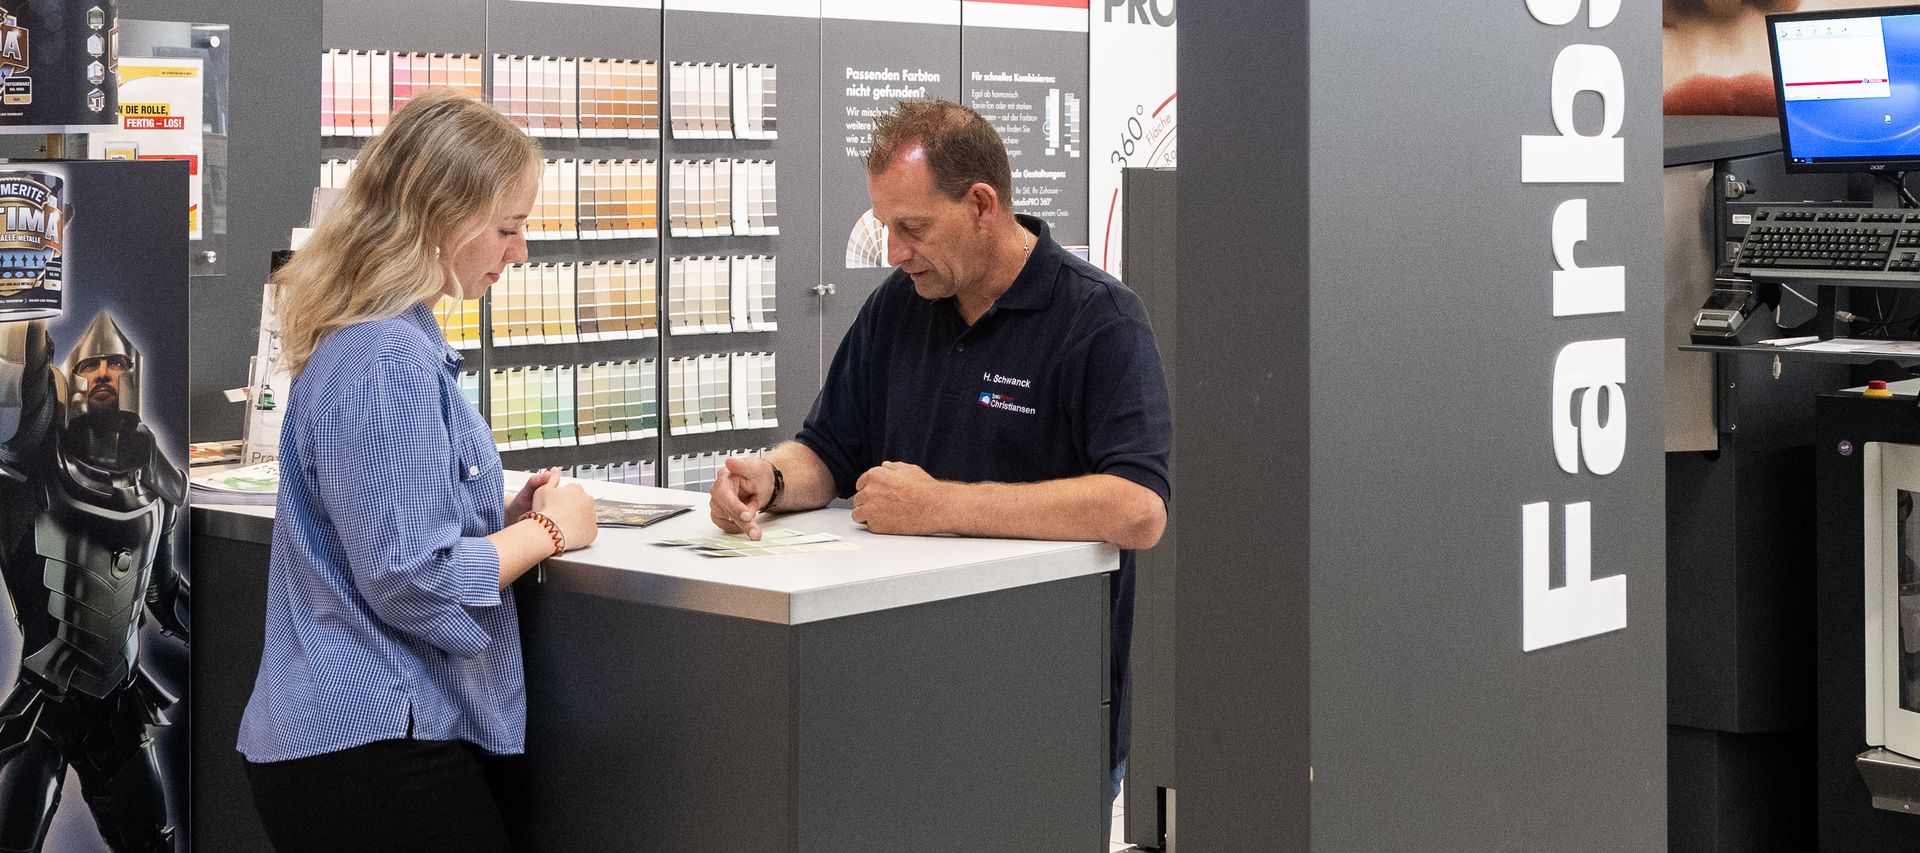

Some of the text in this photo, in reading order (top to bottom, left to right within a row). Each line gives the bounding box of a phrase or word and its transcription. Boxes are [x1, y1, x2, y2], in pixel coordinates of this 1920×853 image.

[846, 67, 940, 82] Passenden Farbton
[971, 71, 1056, 83] Für schnelles Kombinieren:
[846, 83, 926, 100] nicht gefunden?
[971, 89, 1019, 99] Egal ob harmonisch
[126, 105, 138, 114] DIE
[141, 106, 168, 116] ROLLE,
[846, 106, 859, 117] Wir
[995, 102, 1007, 110] oder
[1016, 102, 1032, 111] starken
[1001, 113, 1010, 121] auf
[1010, 113, 1020, 121] der
[127, 118, 154, 128] FERTIG
[164, 118, 182, 128] LOS!
[846, 121, 871, 130] weitere
[1007, 124, 1021, 133] finden
[1022, 125, 1031, 133] Sie
[1146, 114, 1171, 145] Fläche
[846, 134, 858, 143] wie
[1111, 104, 1144, 172] 360°
[1023, 169, 1066, 180] Gestaltungen:
[0, 205, 60, 244] IMA
[18, 234, 41, 244] METALLE
[1521, 0, 1627, 652] Farb
[983, 372, 1030, 387] H. Schwanck
[990, 400, 1035, 414] Christiansen
[252, 451, 279, 464] Pra
